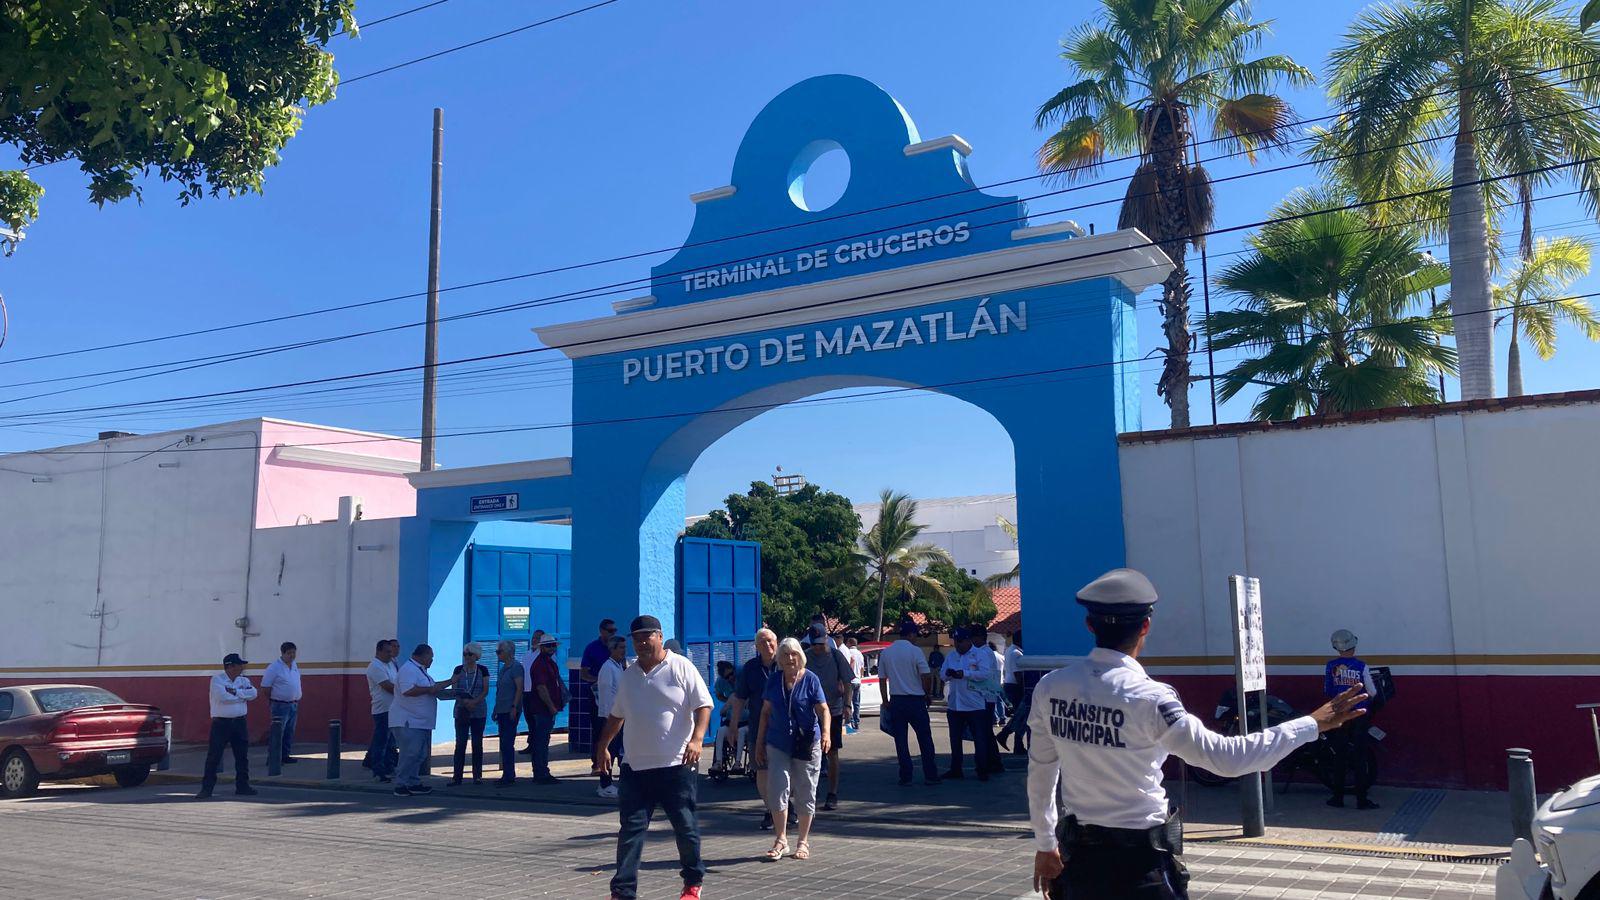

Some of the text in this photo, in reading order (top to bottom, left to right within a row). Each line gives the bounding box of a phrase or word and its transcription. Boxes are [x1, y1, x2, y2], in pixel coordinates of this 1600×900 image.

[681, 221, 970, 292] TERMINAL DE CRUCEROS
[623, 298, 1027, 385] PUERTO DE MAZATLÁN
[1339, 669, 1361, 679] TACOS
[1049, 698, 1124, 728] TRÁNSITO
[1049, 716, 1126, 748] MUNICIPAL
